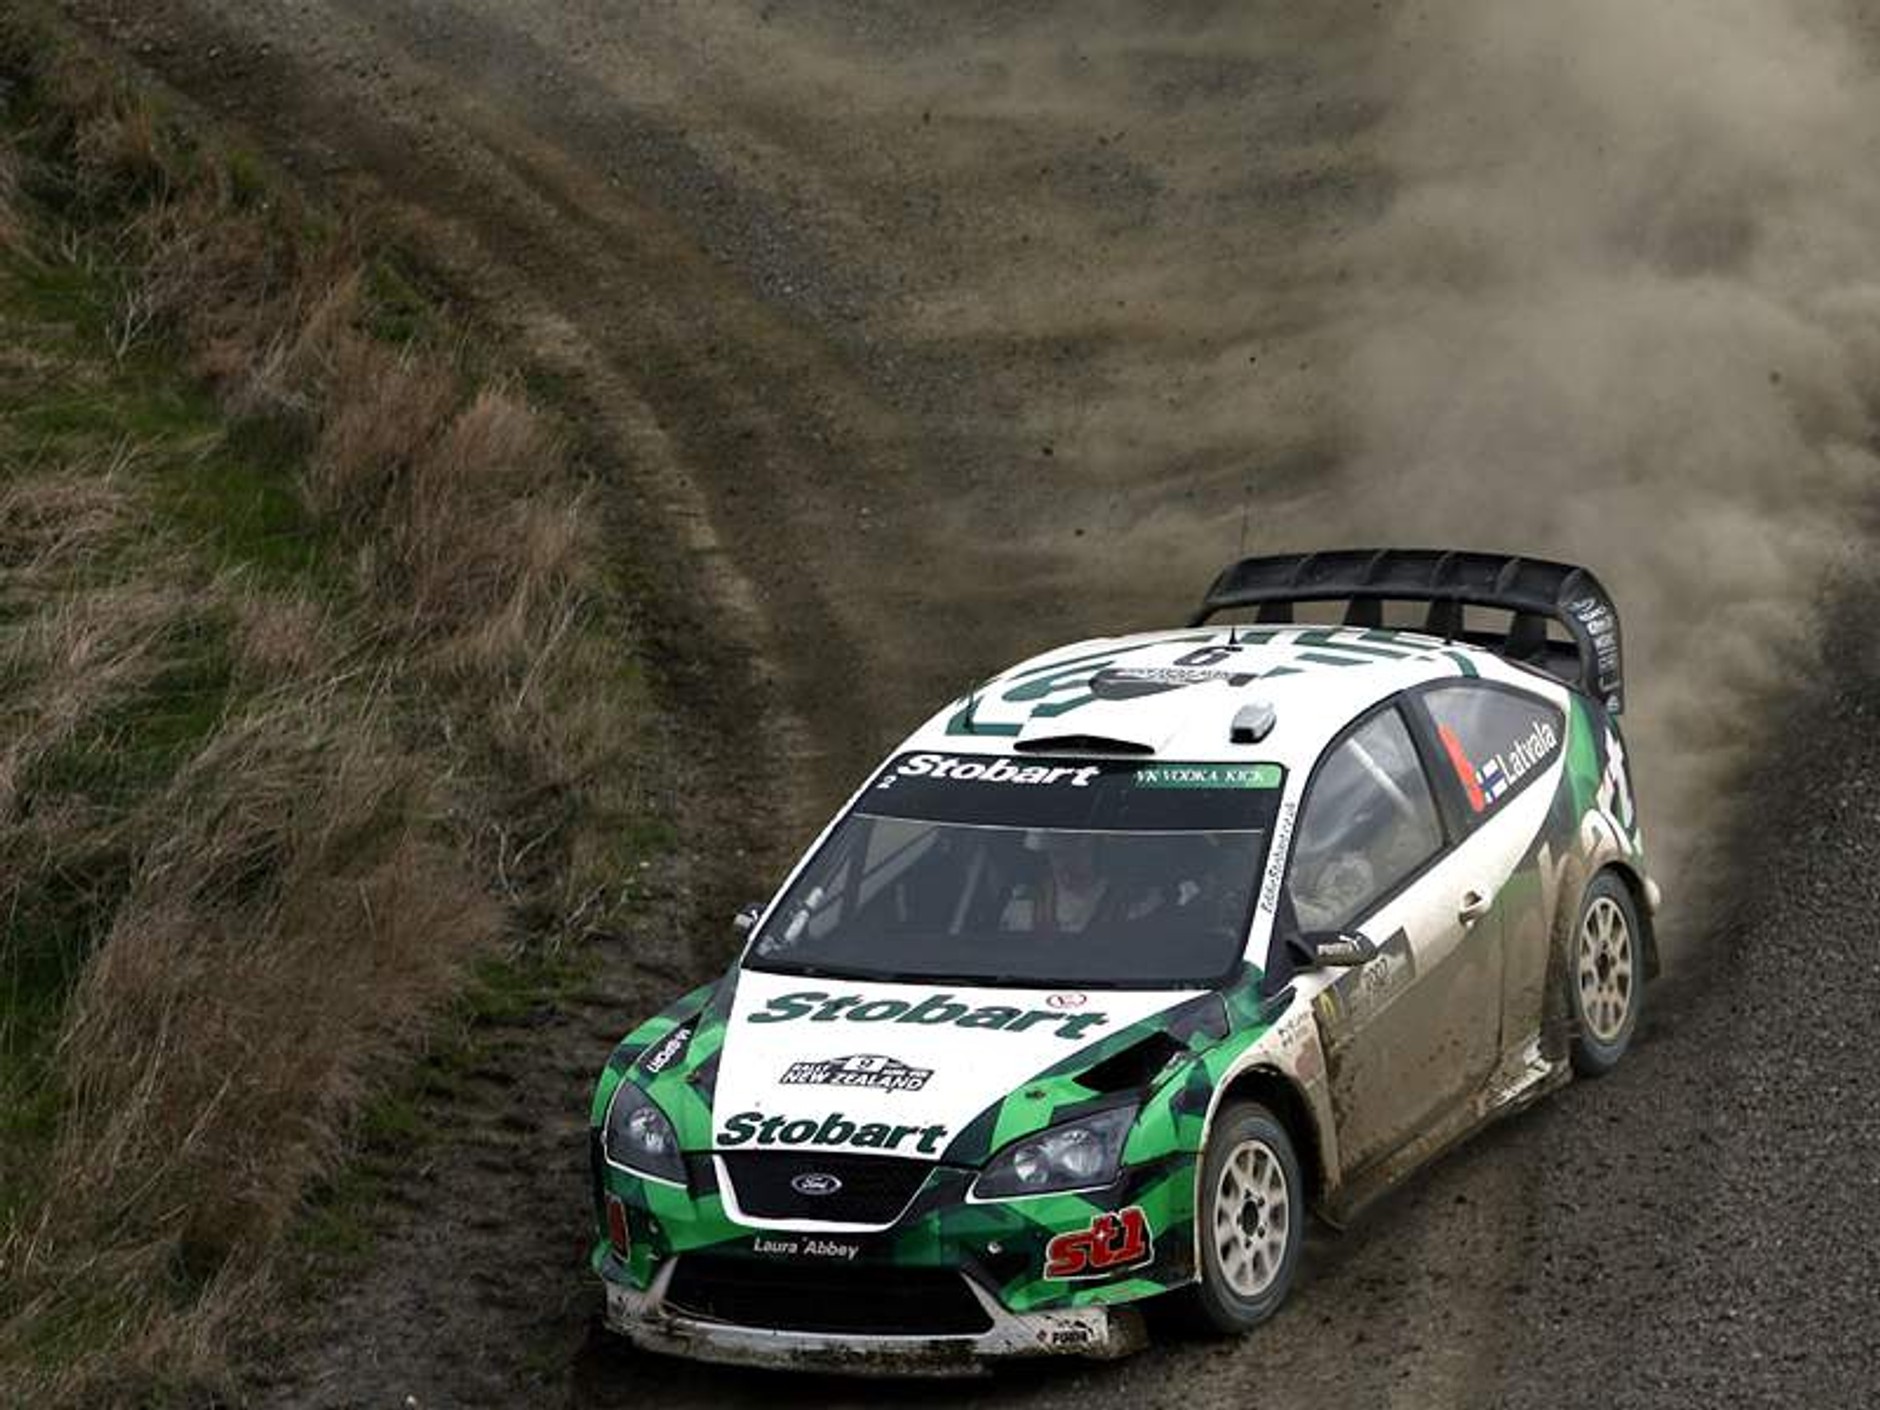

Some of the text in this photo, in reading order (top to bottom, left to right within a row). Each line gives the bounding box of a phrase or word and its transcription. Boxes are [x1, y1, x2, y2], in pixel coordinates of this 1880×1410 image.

[897, 753, 1100, 787] Stobart
[1496, 721, 1557, 785] Latvala
[747, 991, 1110, 1039] Stobart
[783, 1071, 831, 1084] NEW
[831, 1073, 924, 1090] ZEALAND
[717, 1111, 948, 1153] Stobart
[754, 1237, 859, 1260] Laura Abbey
